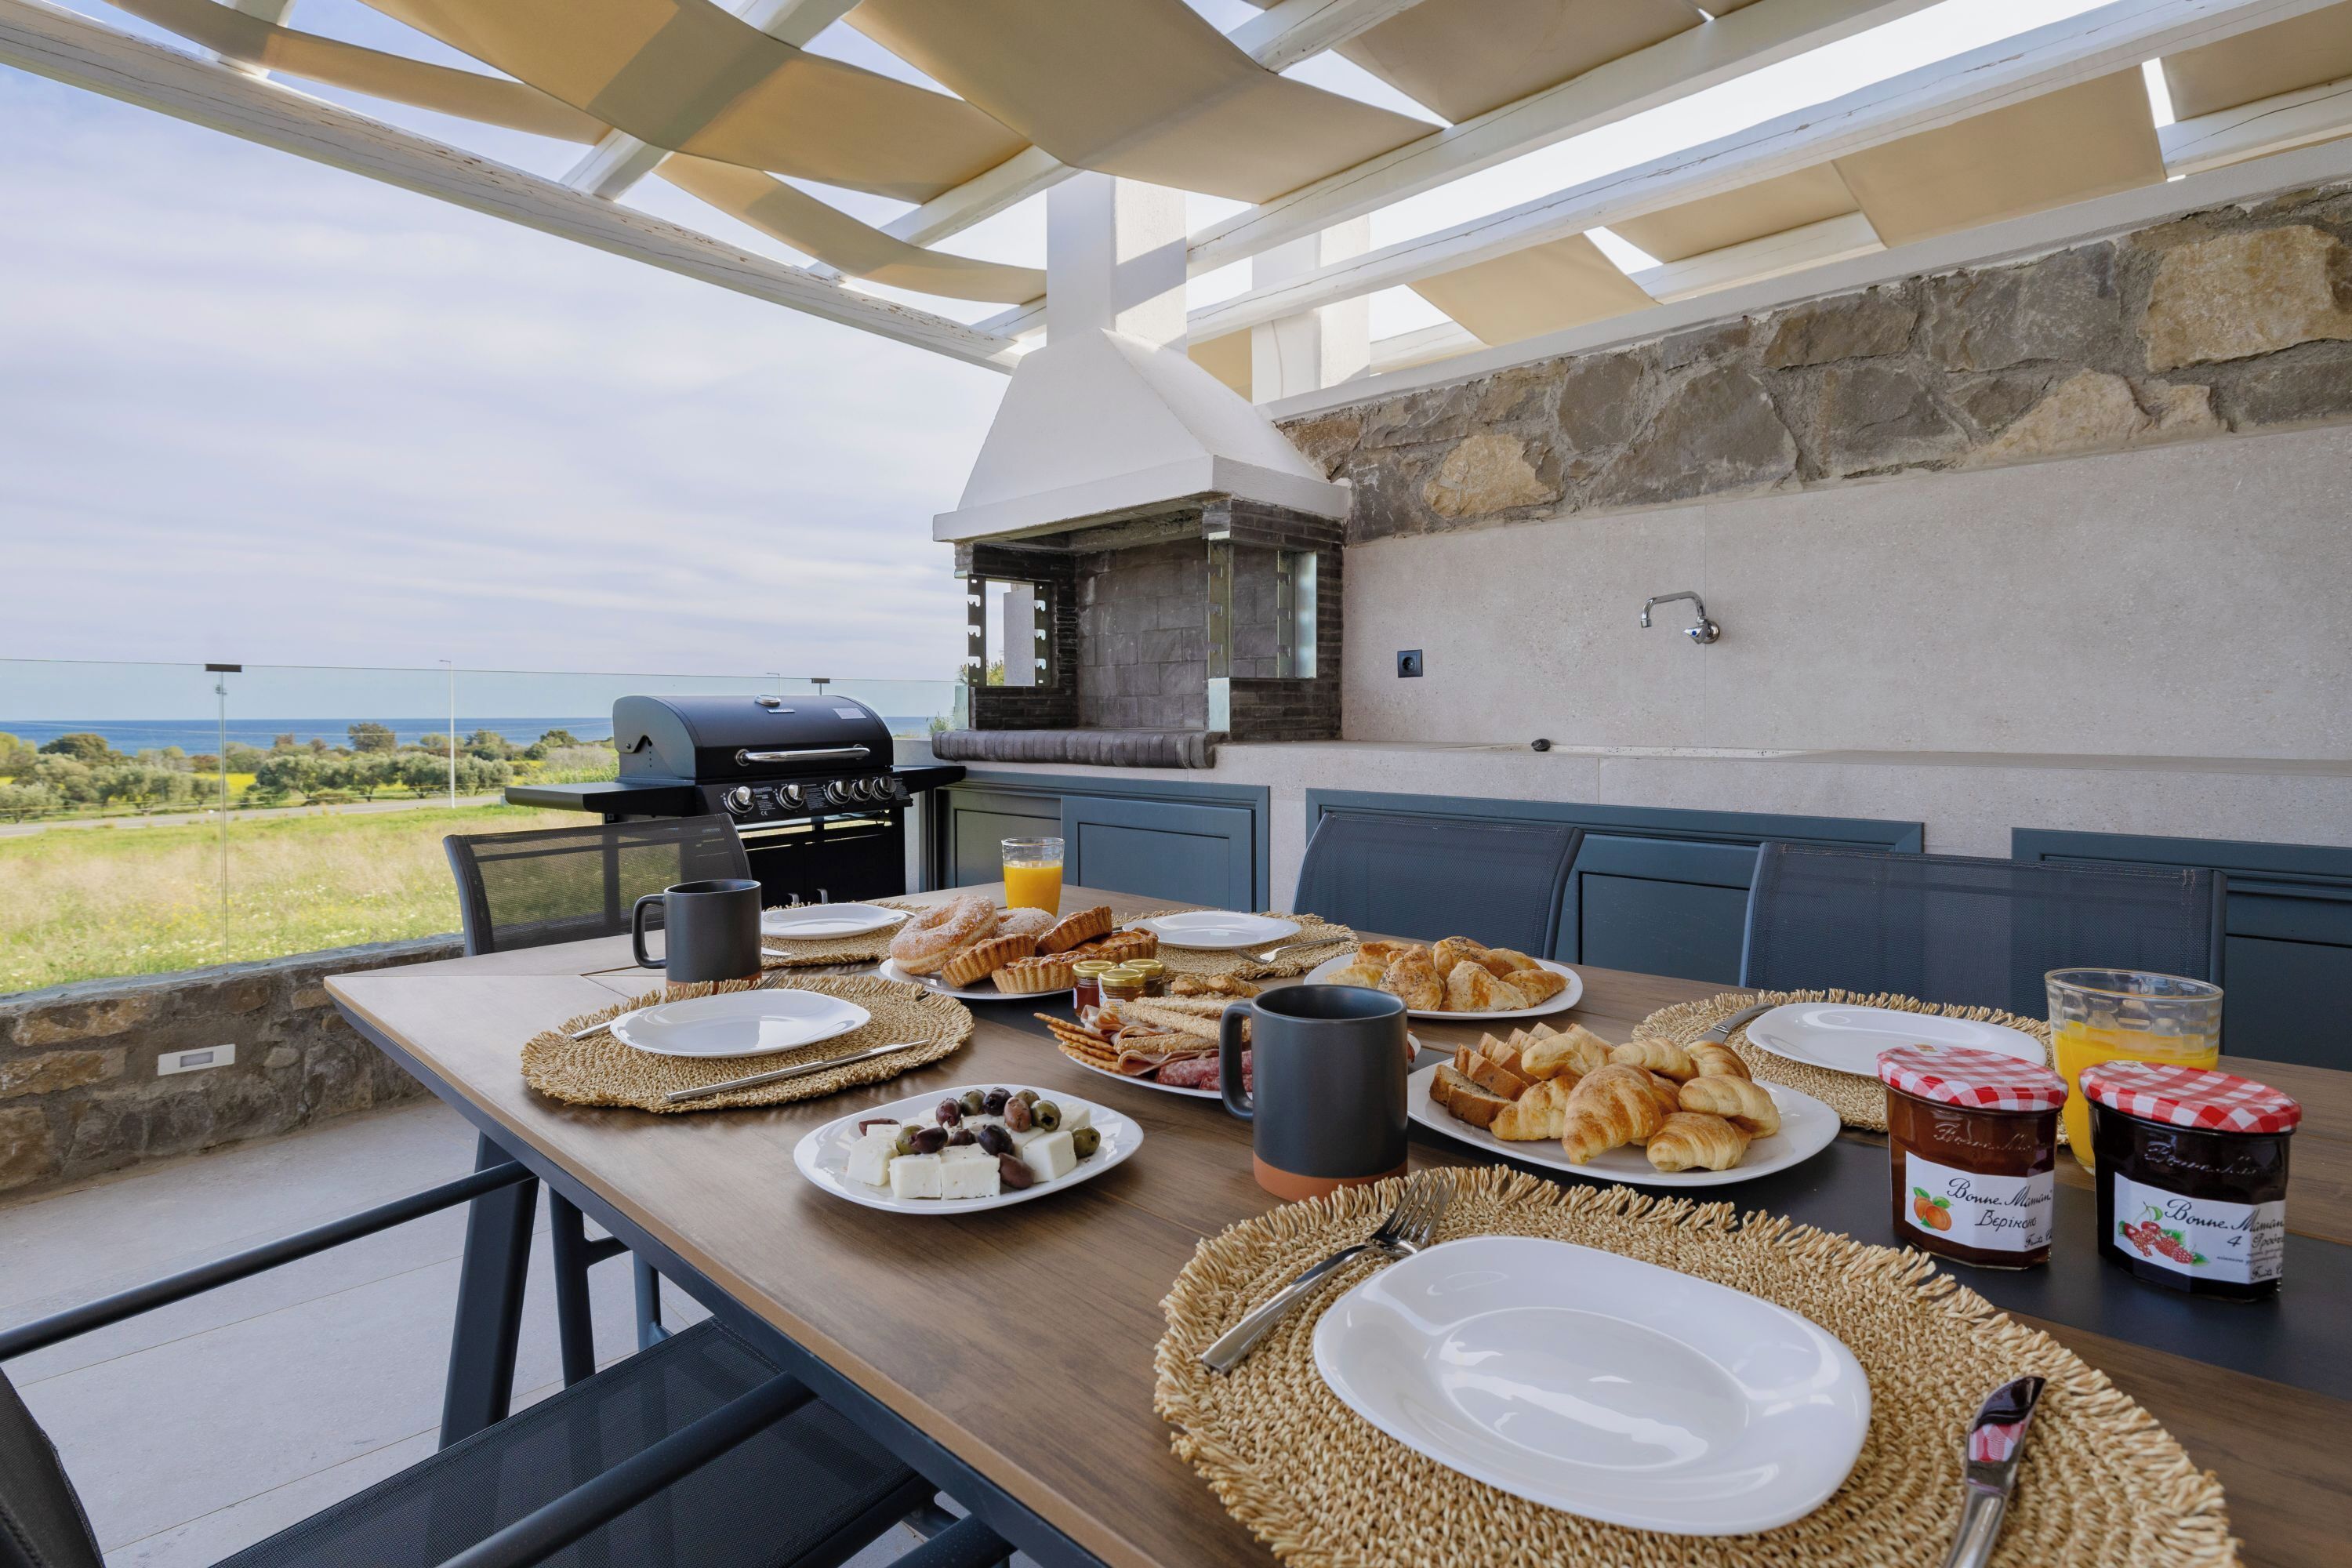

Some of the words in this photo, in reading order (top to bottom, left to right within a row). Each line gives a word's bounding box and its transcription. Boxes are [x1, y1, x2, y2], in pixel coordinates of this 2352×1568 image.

[1947, 1178, 2002, 1206] Bonne
[2164, 1199, 2229, 1229] Bonne
[2230, 1209, 2285, 1232] Maman
[2227, 1235, 2243, 1247] 4
